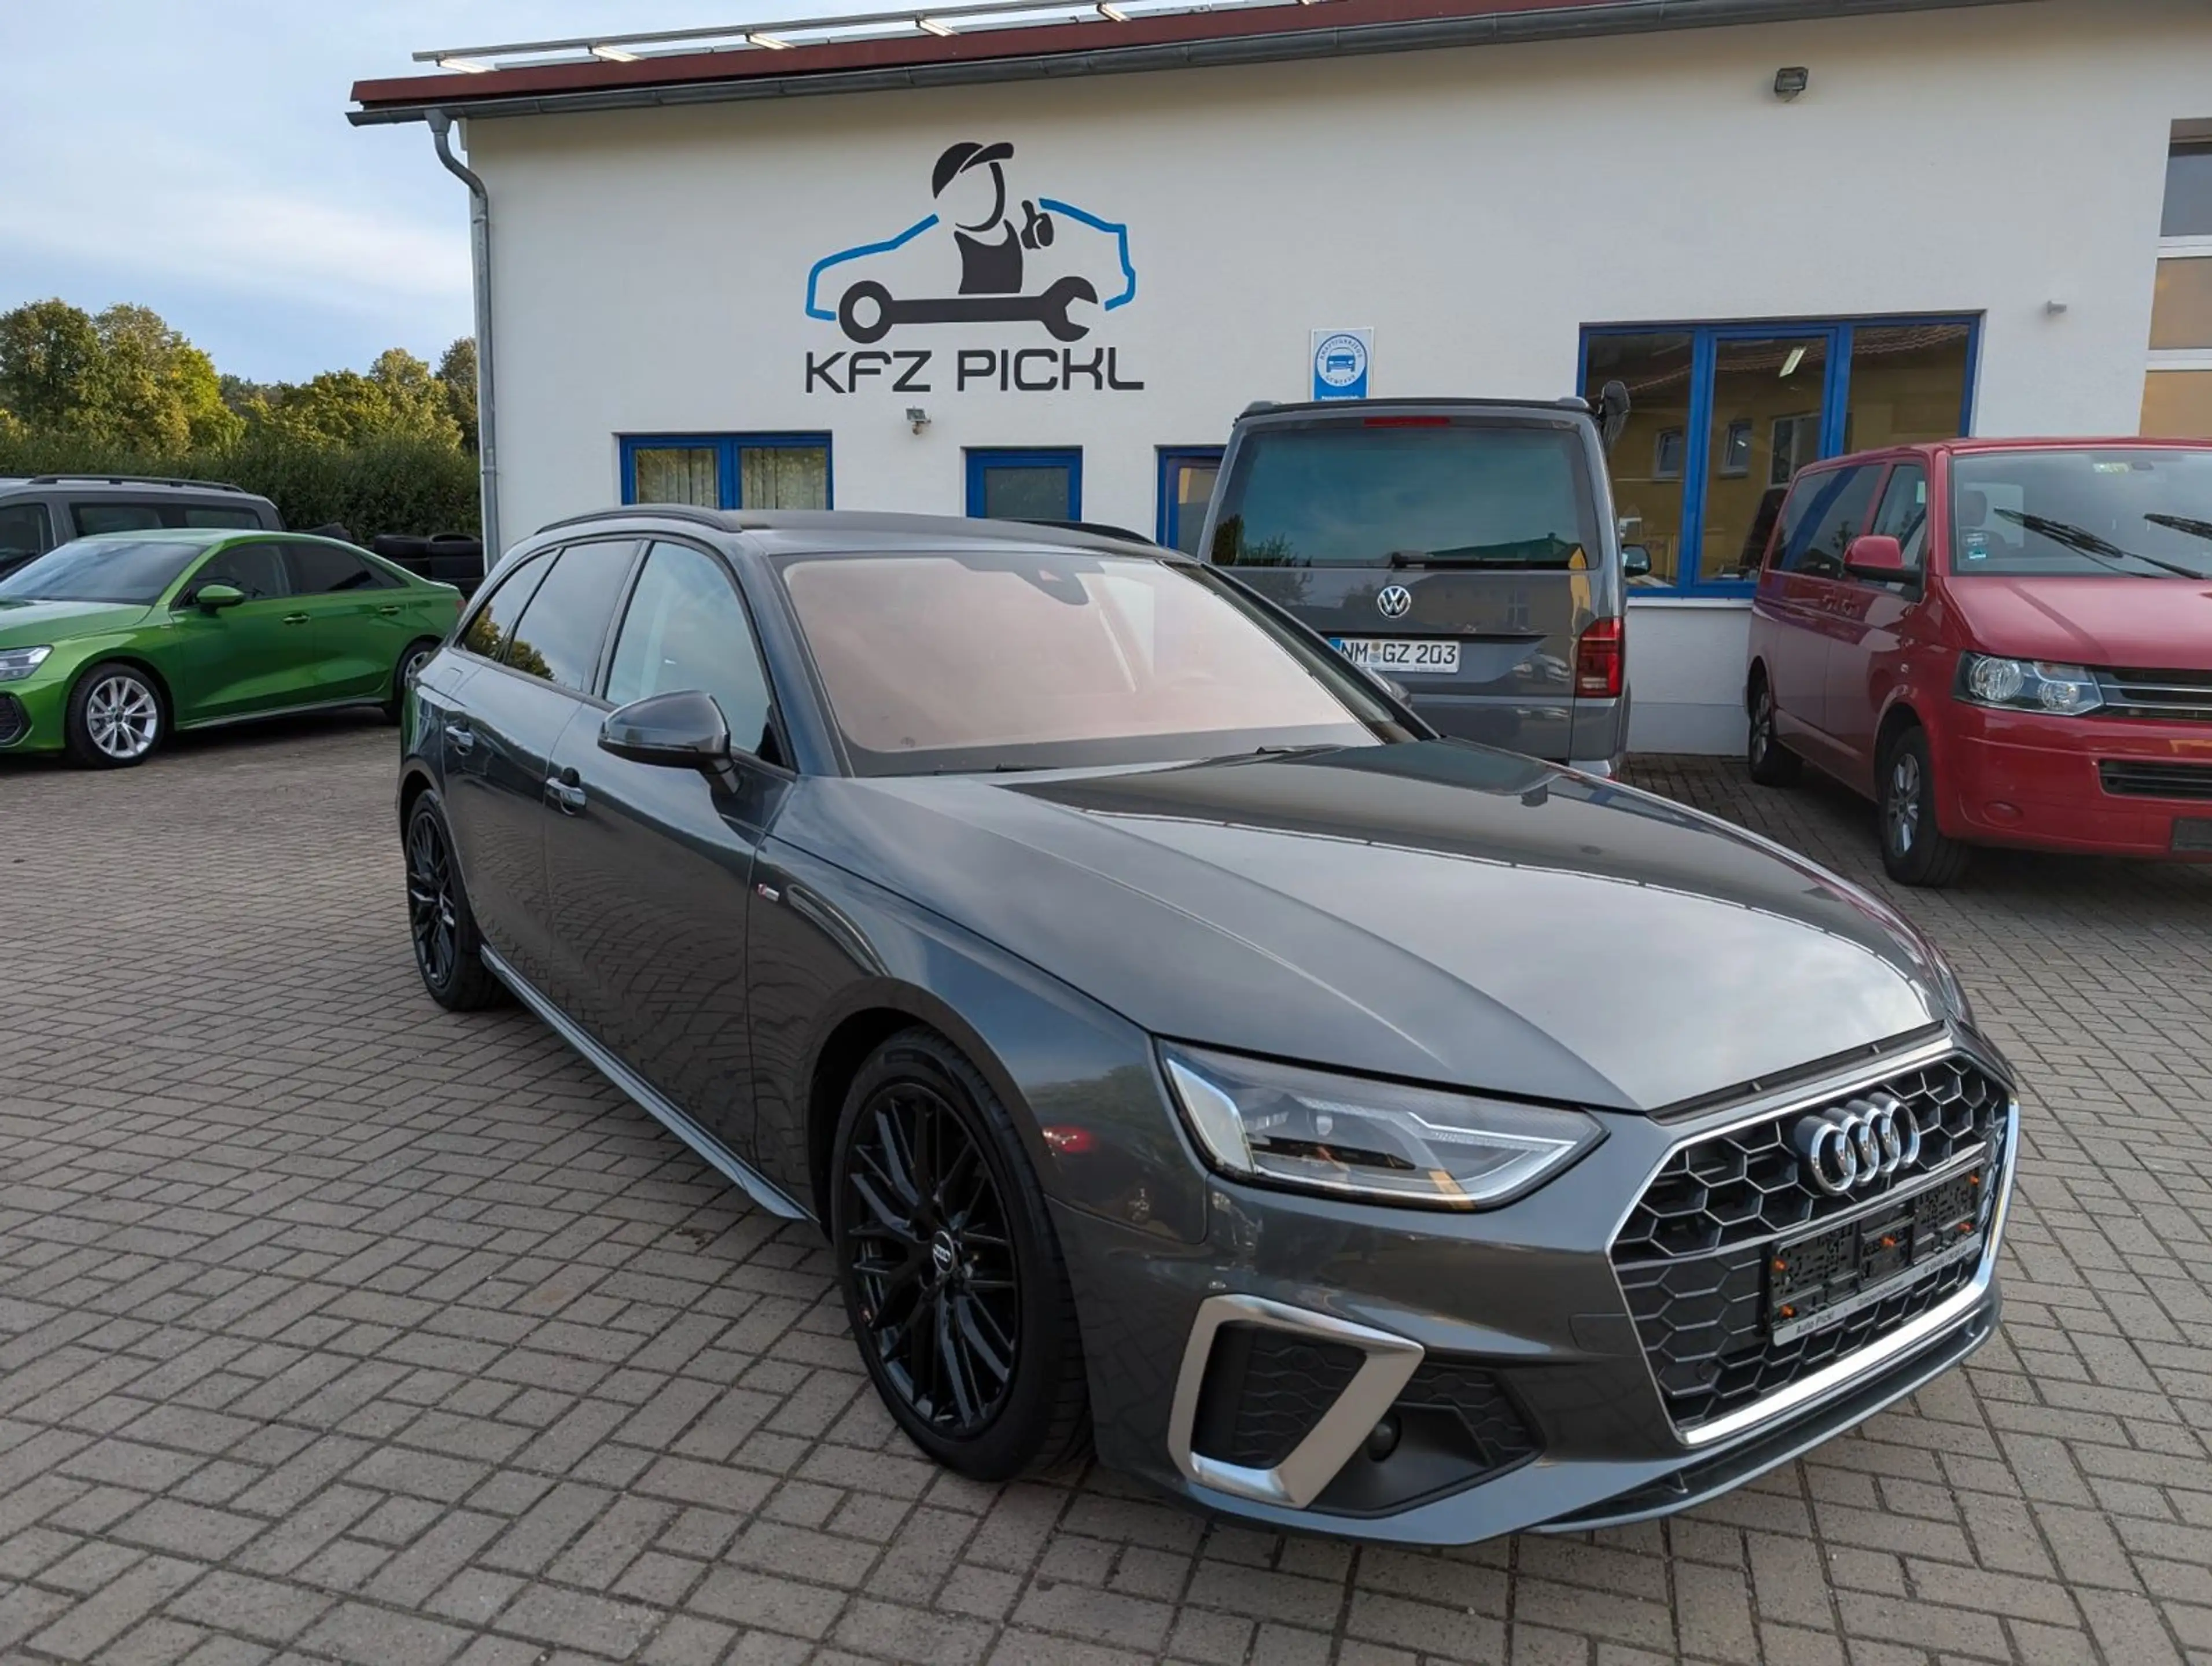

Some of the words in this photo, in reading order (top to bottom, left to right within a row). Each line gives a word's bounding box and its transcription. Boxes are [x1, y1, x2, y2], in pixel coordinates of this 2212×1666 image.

[805, 351, 932, 393] KFZ
[958, 347, 1144, 392] PICKL
[1341, 642, 1368, 663] NM
[1382, 643, 1411, 664] GZ
[1415, 644, 1457, 665] 203
